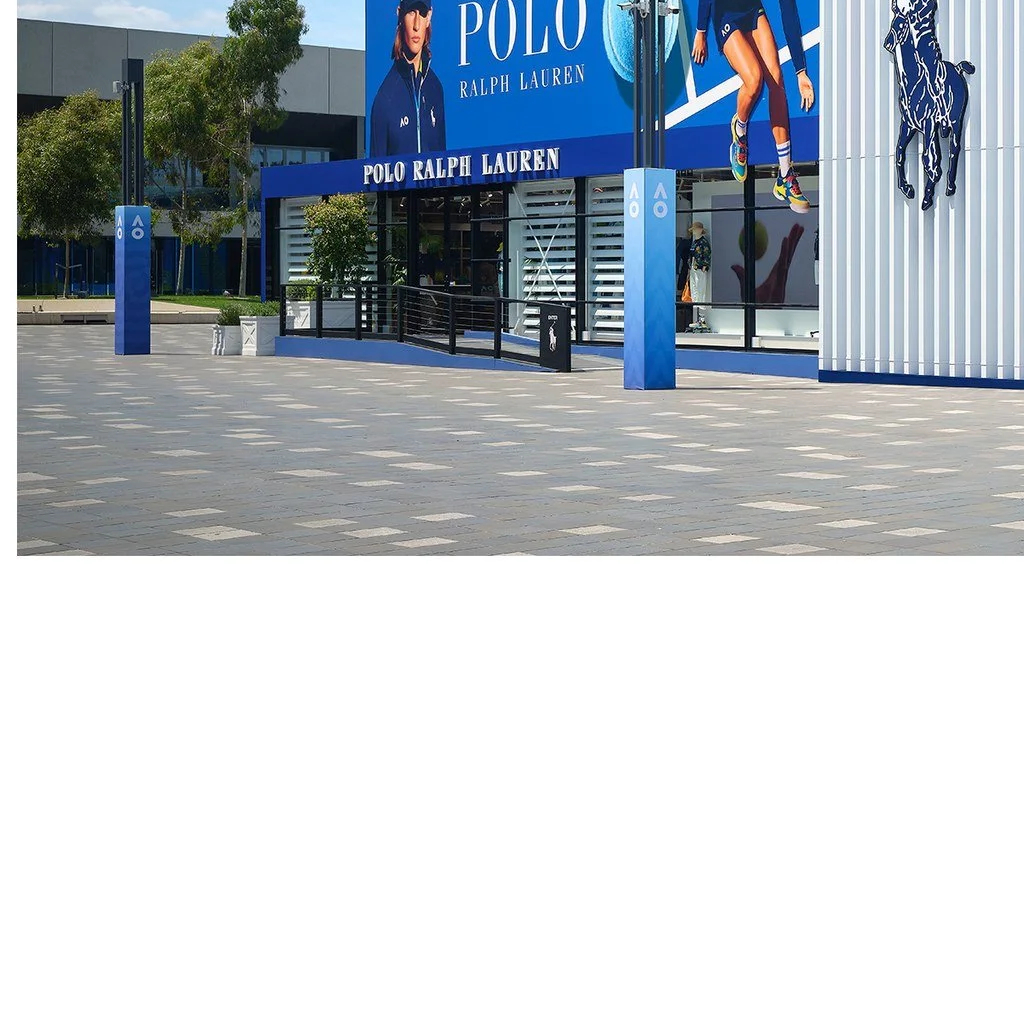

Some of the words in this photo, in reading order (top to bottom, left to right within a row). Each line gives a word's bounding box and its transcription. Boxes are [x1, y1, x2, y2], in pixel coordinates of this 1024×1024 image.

[459, 71, 510, 99] RALPH
[519, 64, 585, 92] LAUREN
[363, 161, 406, 184] POLO
[413, 155, 472, 181] RALPH
[481, 147, 560, 176] LAUREN
[653, 182, 668, 219] AO
[131, 214, 145, 240] AO
